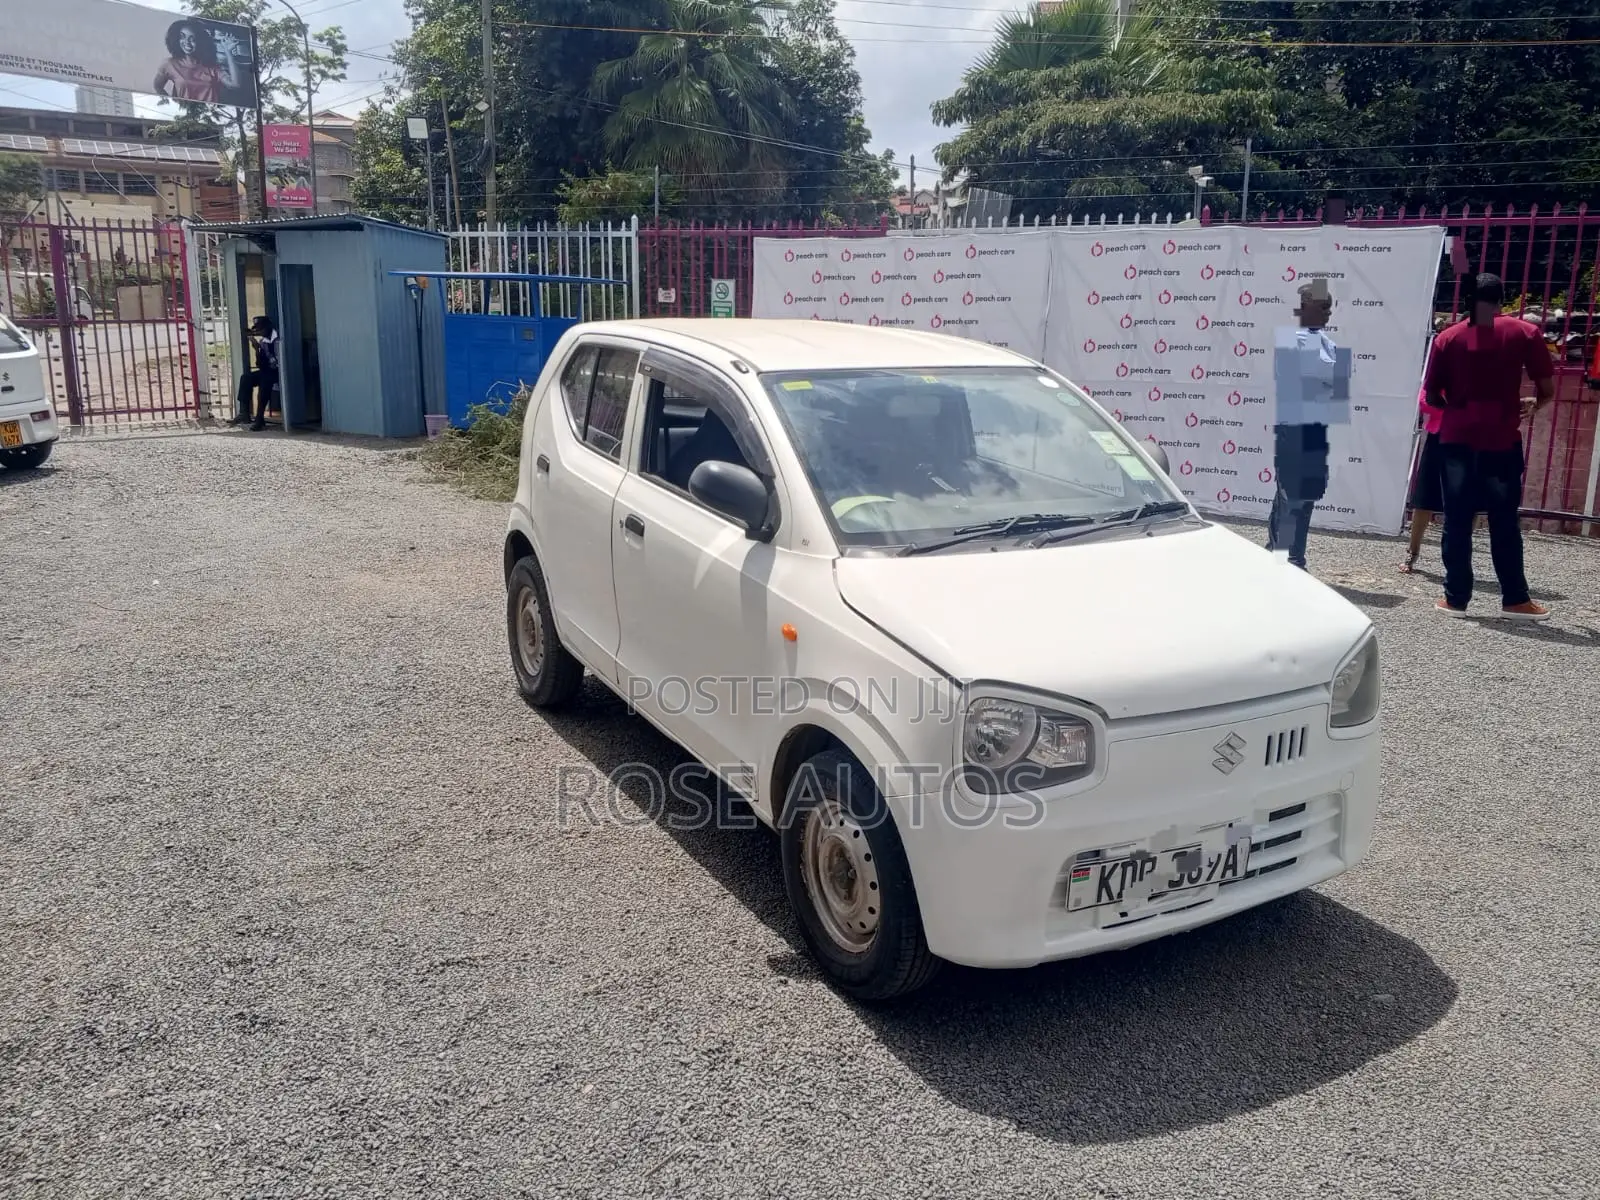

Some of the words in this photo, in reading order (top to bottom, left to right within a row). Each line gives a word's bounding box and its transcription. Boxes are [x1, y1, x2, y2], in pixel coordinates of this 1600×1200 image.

[44, 66, 60, 74] CAR
[978, 248, 999, 257] peach
[1105, 244, 1128, 254] peach
[1178, 243, 1202, 253] peach
[796, 252, 814, 261] peach
[853, 252, 872, 261] peach
[916, 250, 936, 259] peach
[823, 273, 841, 282] peach
[883, 273, 902, 282] peach
[946, 272, 966, 281] peach
[1138, 268, 1162, 278] peach
[1216, 268, 1240, 278] peach
[795, 296, 813, 304] peach
[851, 296, 870, 304] peach
[914, 296, 933, 304] peach
[975, 295, 995, 303] peach
[1102, 294, 1124, 303] peach
[1174, 293, 1197, 303] peach
[1254, 296, 1280, 304] peach
[881, 318, 899, 326] peach
[943, 318, 963, 327] peach
[1133, 317, 1157, 327] peach
[1211, 320, 1235, 328] peach
[1098, 342, 1120, 351] peach
[1169, 344, 1192, 352] peach
[1130, 367, 1153, 375] peach
[1206, 370, 1230, 379] peach
[1092, 389, 1114, 398] peach
[1163, 392, 1186, 400] peach
[1124, 413, 1147, 422] peach
[1200, 418, 1224, 426] peach
[1158, 440, 1182, 449] peach
[1238, 445, 1262, 454] peach
[1195, 467, 1219, 475] peach
[1232, 494, 1257, 502] peach
